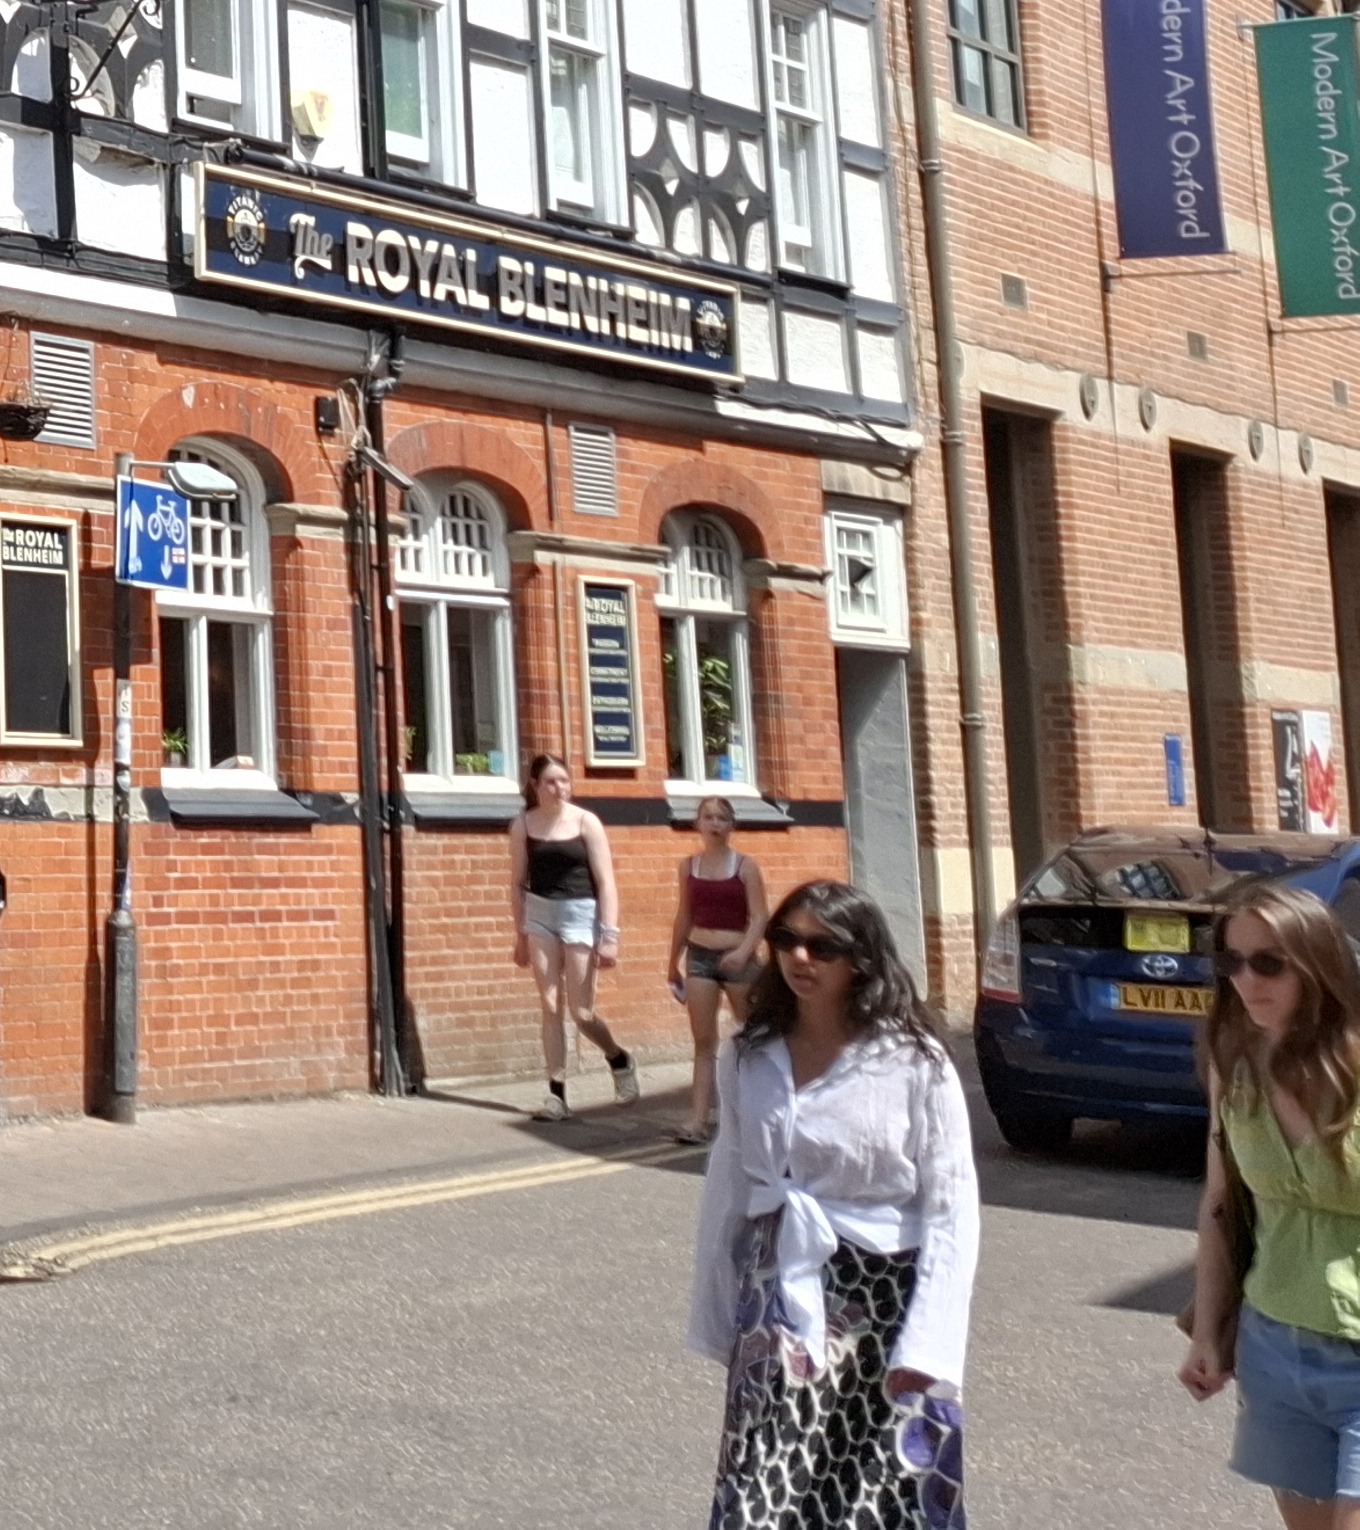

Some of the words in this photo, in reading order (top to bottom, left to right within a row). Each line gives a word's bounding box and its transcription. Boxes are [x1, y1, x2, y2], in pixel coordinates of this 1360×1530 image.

[1164, 69, 1196, 125] Art
[1310, 32, 1343, 140] Modern
[1170, 130, 1211, 239] Oxford
[1318, 146, 1352, 197] Art
[1328, 201, 1360, 300] Oxford
[290, 212, 333, 280] The
[346, 221, 490, 311] ROYAL
[498, 255, 694, 354] BLENHEIM
[2, 545, 64, 565] BLENHEIM
[15, 529, 63, 550] ROYAL
[1122, 987, 1167, 1009] LV11
